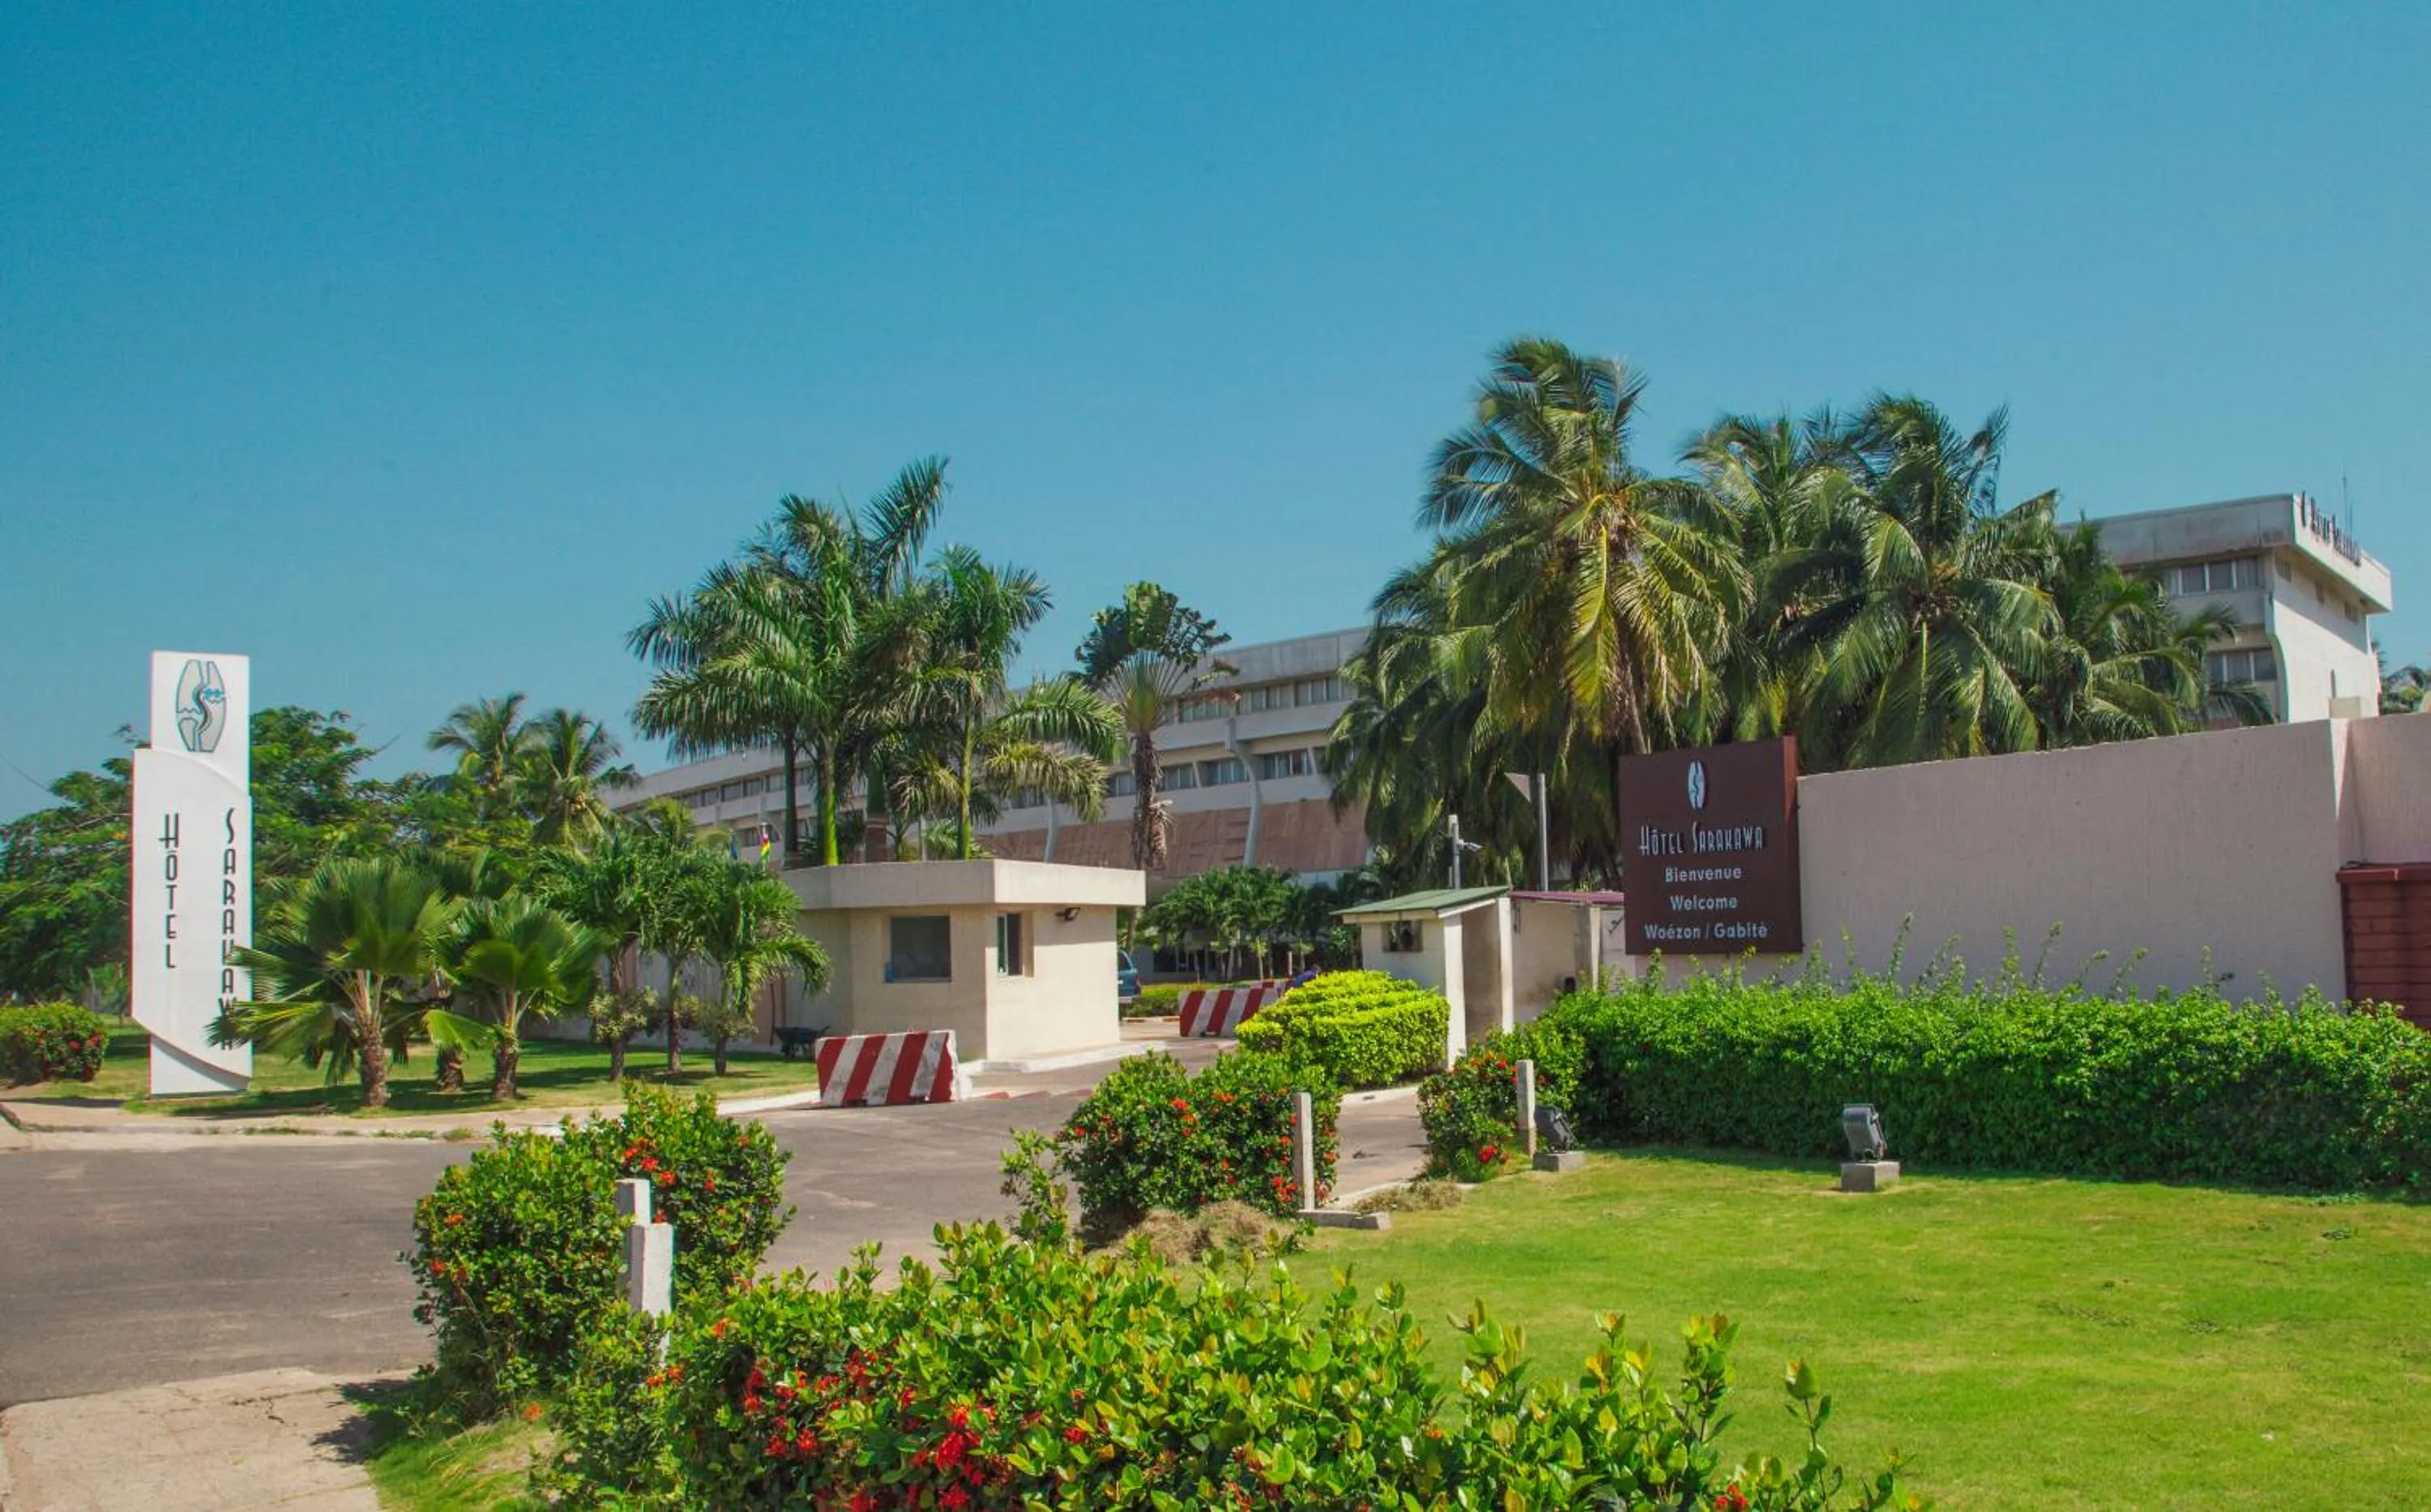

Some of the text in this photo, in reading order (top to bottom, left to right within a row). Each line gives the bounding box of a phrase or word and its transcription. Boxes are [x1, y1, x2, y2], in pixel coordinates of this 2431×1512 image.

[1691, 820, 1762, 853] SARAKAWA
[1665, 867, 1742, 882] Bienvenue
[158, 813, 179, 969] HÔTEL
[1670, 895, 1738, 911] Welcome
[1644, 923, 1701, 940] Woézon
